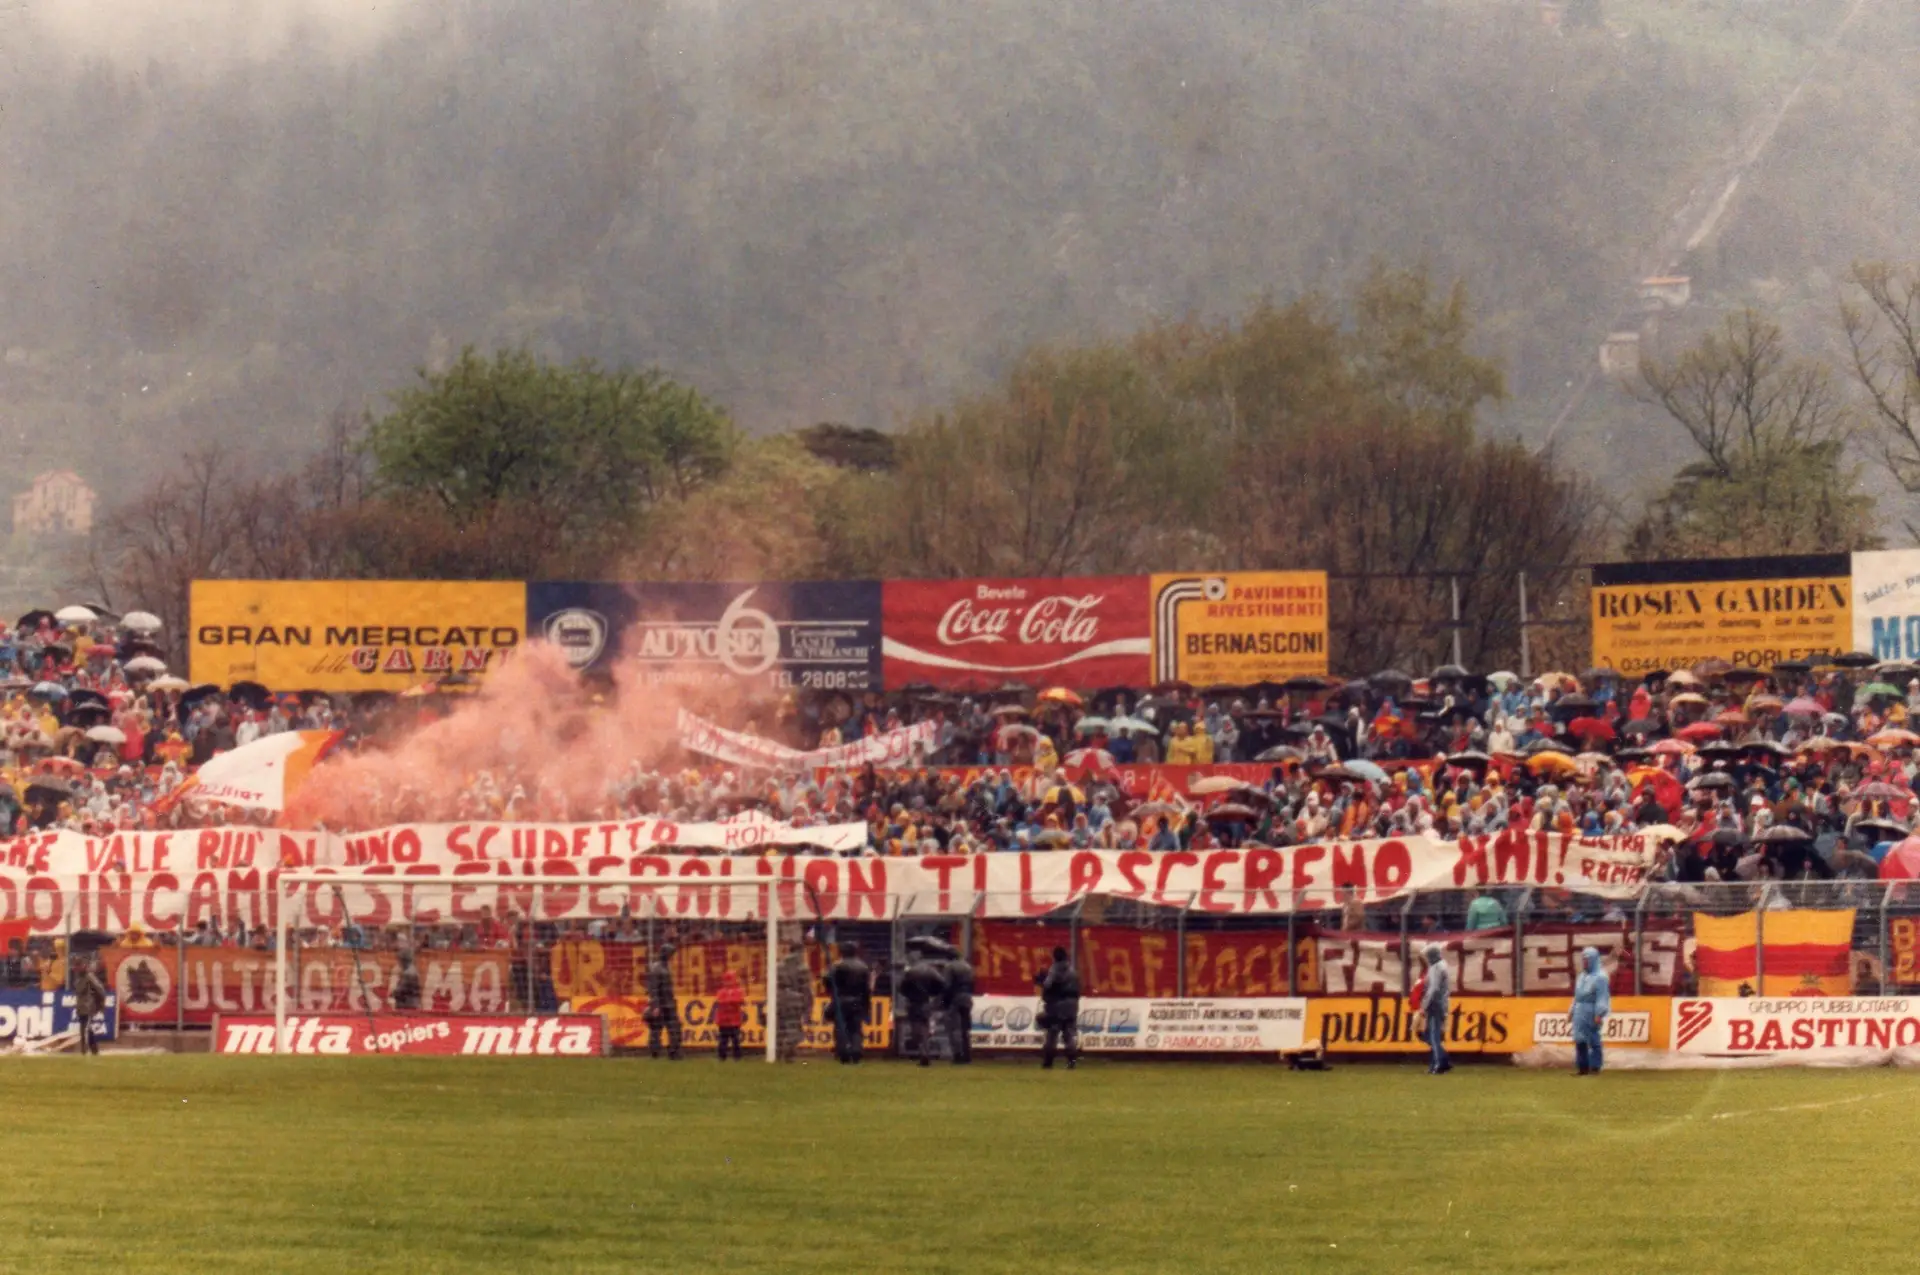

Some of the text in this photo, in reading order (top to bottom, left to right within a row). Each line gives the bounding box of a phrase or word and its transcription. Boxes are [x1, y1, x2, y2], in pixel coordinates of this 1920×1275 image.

[977, 584, 1026, 600] Bevete
[1233, 586, 1323, 601] PAVIMENTI
[1598, 582, 1849, 618] ROSEN GARDEN
[1207, 602, 1323, 617] RIVESTIMENTI
[199, 625, 518, 646] GRAN MERCATO
[1186, 631, 1323, 655] BERNASCONI
[86, 834, 173, 873] VALE
[143, 867, 343, 931] CAMPO
[756, 855, 887, 920] NON
[920, 852, 987, 918] TI
[1747, 999, 1910, 1014] GRUPPO PUBBLICITARIO
[223, 1016, 351, 1054] mita
[363, 1020, 450, 1053] copiers
[461, 1017, 593, 1055] mita
[1321, 996, 1510, 1054] publitas
